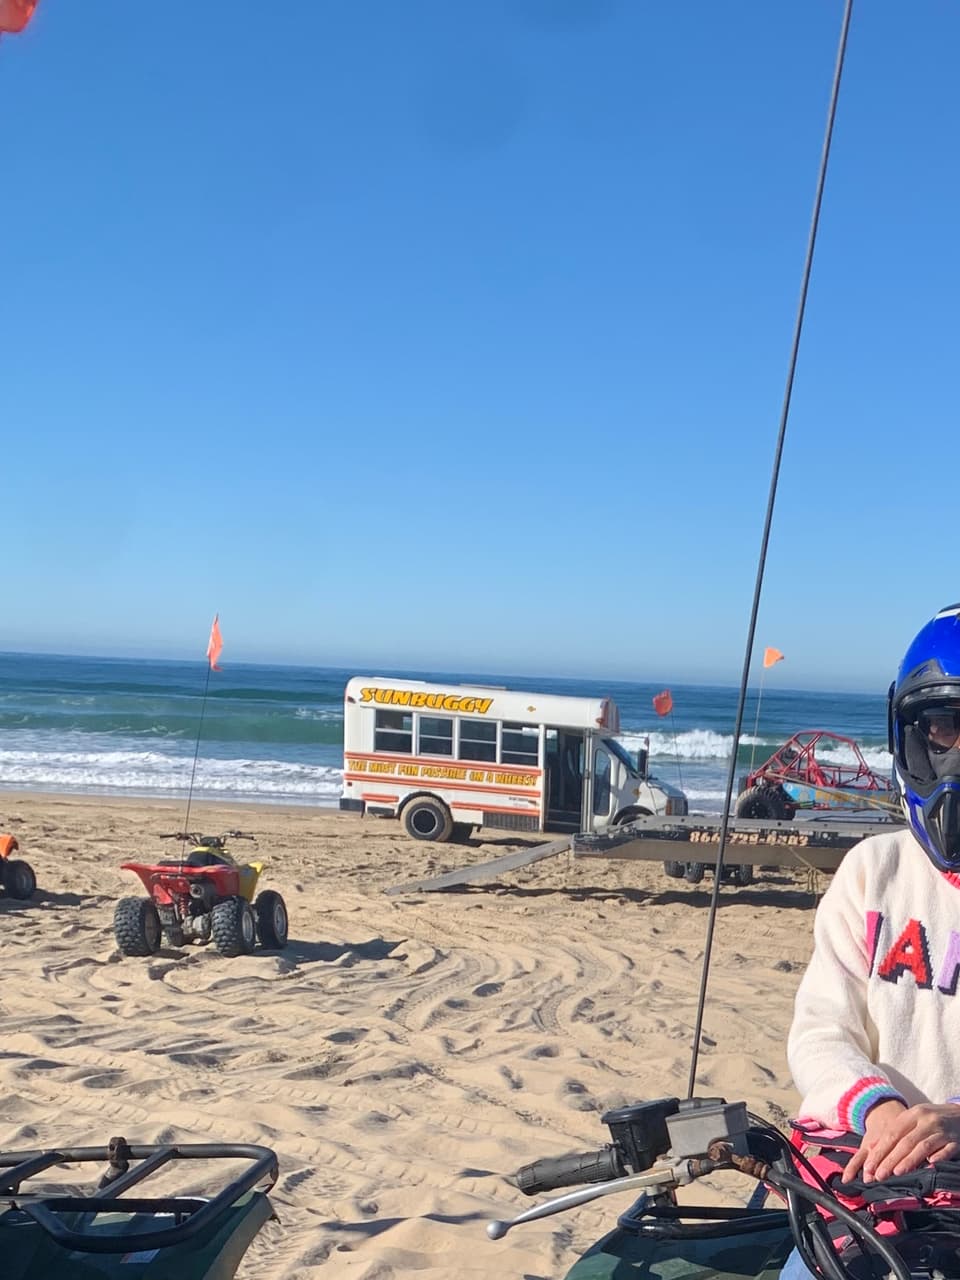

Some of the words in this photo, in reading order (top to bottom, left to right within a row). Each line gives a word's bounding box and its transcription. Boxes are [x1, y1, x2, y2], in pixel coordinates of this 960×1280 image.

[360, 687, 494, 714] SUNBUGGY
[369, 761, 395, 774] MOST
[398, 764, 419, 776] FUN
